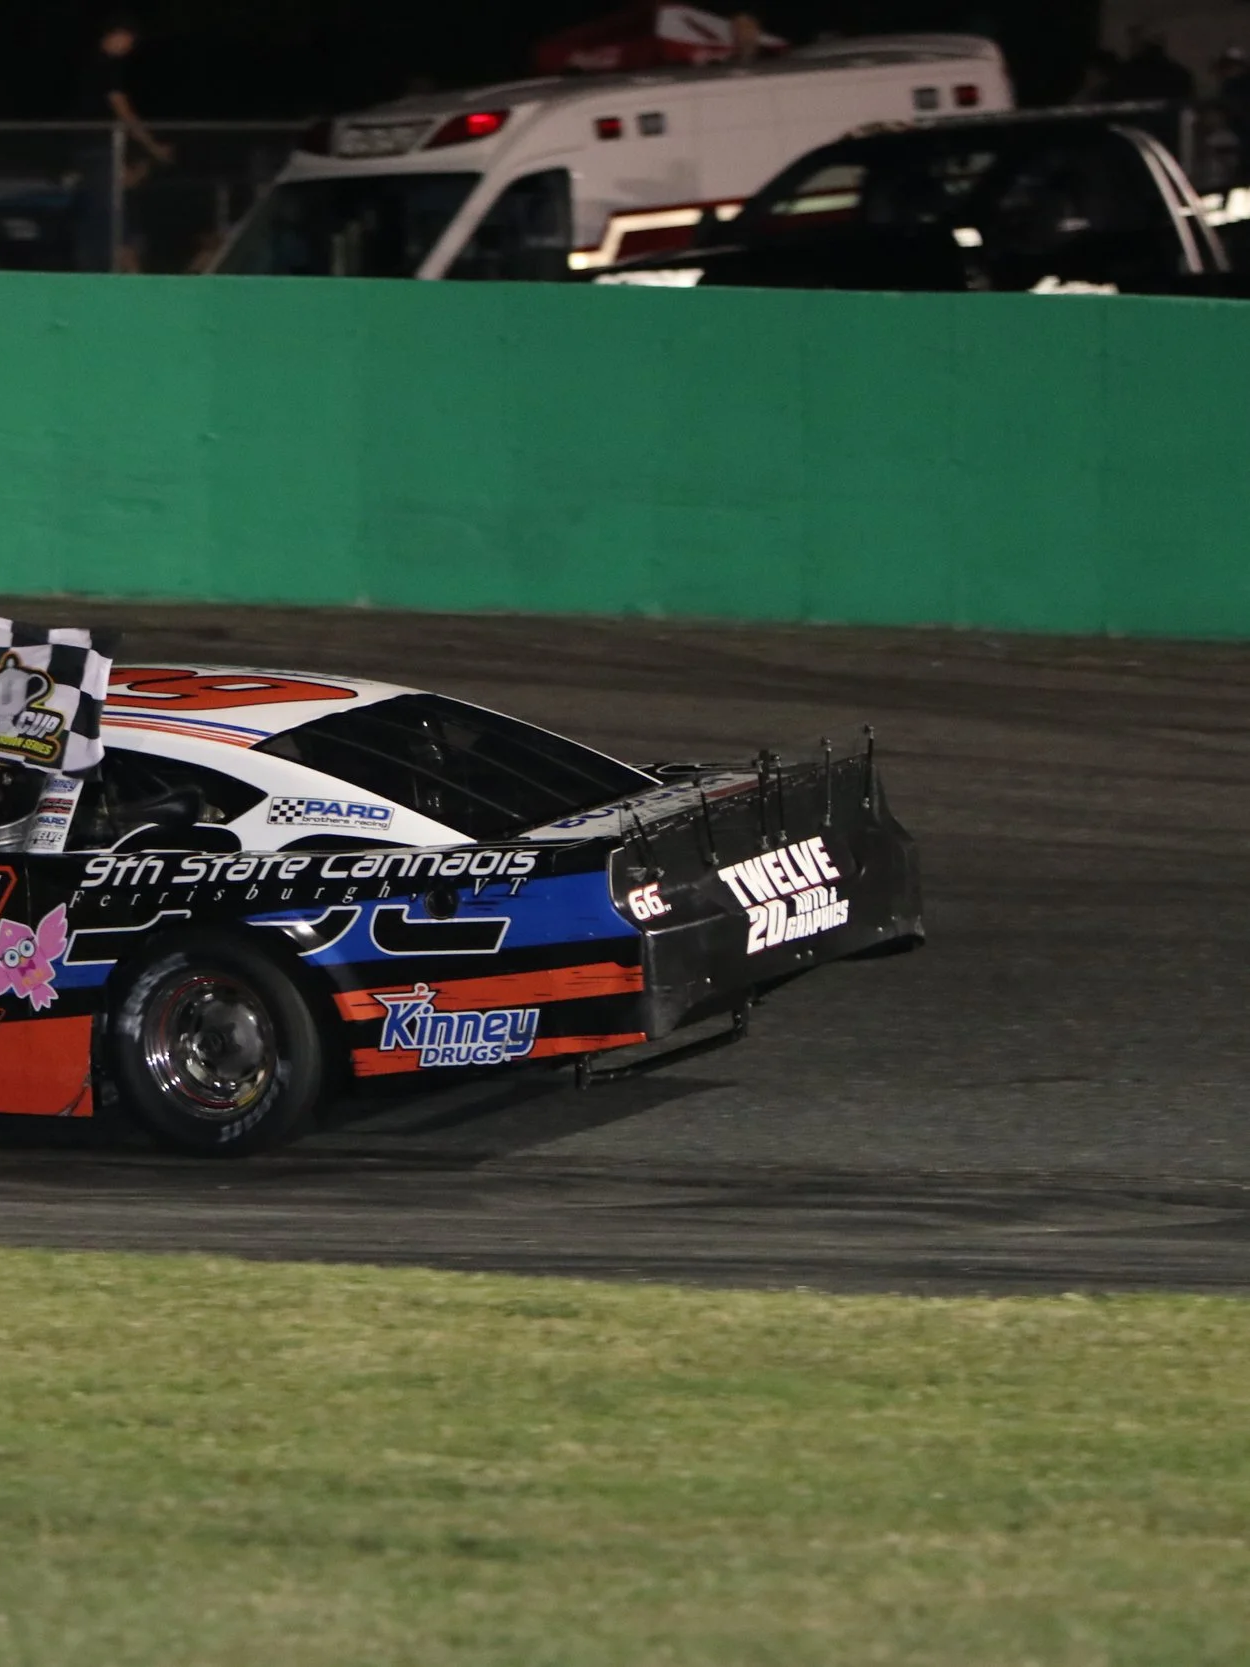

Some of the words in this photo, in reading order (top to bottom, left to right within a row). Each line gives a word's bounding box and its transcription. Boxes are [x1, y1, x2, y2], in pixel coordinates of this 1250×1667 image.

[16, 710, 61, 739] CUP
[302, 816, 350, 825] brothers
[354, 819, 388, 829] racing
[305, 800, 391, 821] PARD
[80, 854, 165, 888] 9th
[171, 854, 312, 884] State
[717, 836, 841, 908] TWELVE
[627, 882, 666, 921] 66
[791, 885, 829, 915] AUTO
[784, 899, 850, 943] GRAPHICS
[380, 998, 540, 1055] Kinney
[421, 1044, 503, 1067] DRUGS
